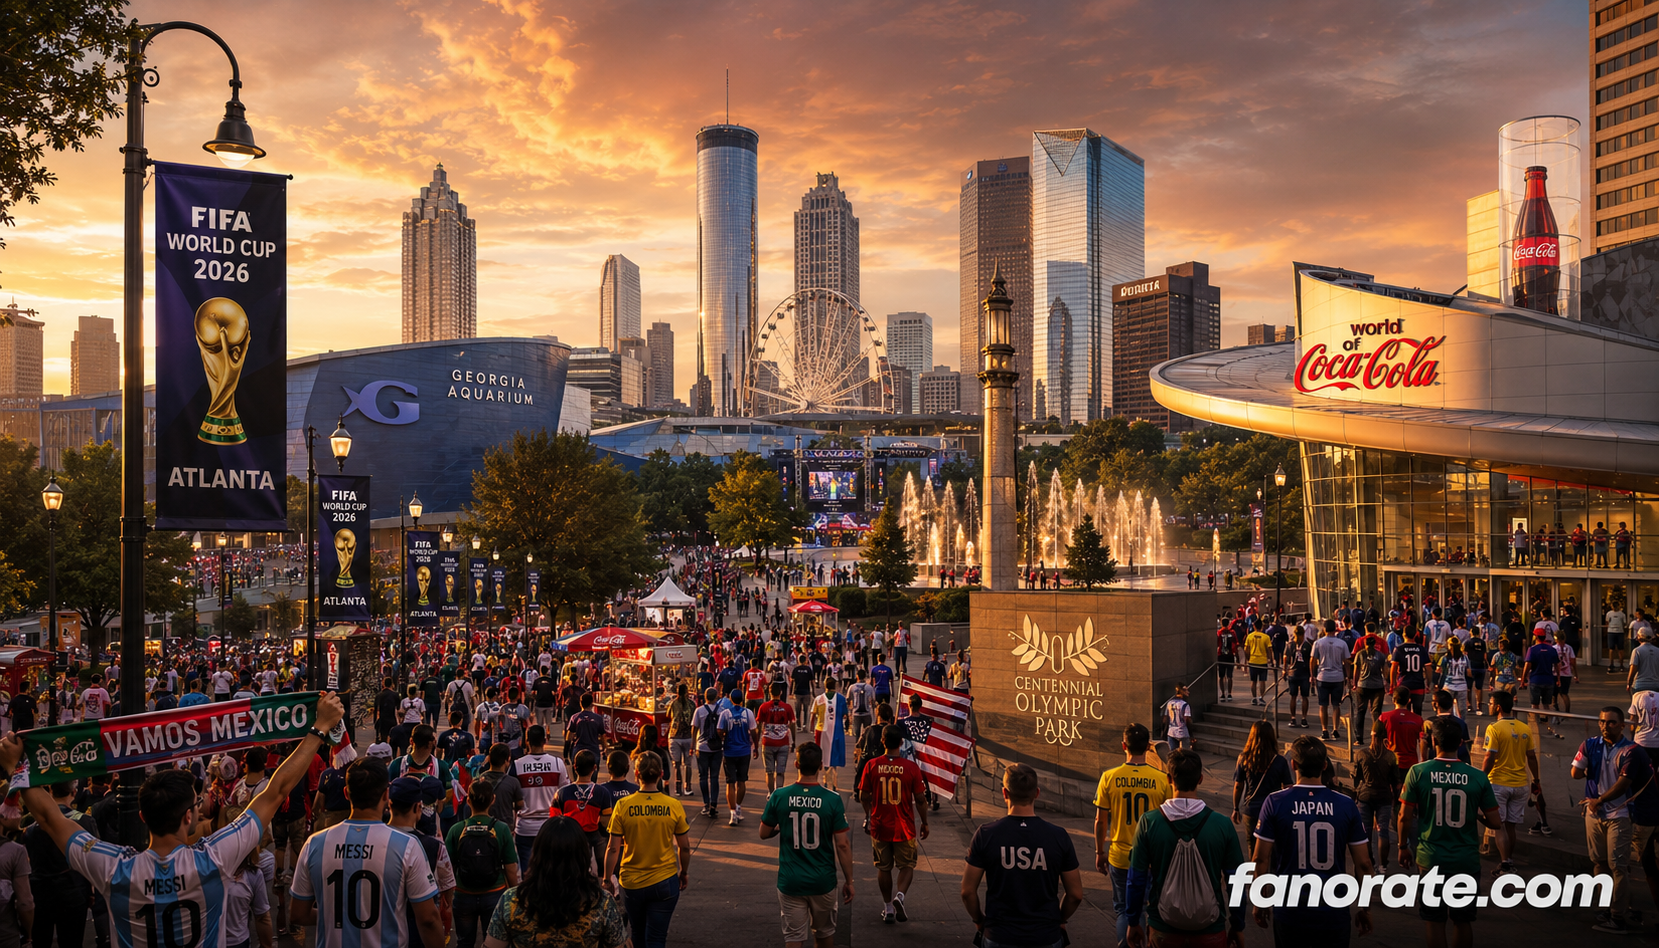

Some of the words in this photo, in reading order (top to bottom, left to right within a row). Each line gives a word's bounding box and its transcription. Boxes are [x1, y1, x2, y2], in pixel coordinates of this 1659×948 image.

[191, 206, 253, 233] FIFA
[166, 232, 235, 256] WORLD
[240, 238, 276, 258] CUP
[194, 258, 250, 283] 2026
[1350, 318, 1404, 337] world
[1342, 337, 1361, 352] of
[1293, 335, 1446, 393] Coca-Cola
[452, 369, 526, 390] GEORGIA
[447, 385, 534, 406] AQUARIUM
[167, 466, 276, 491] ATLANTA
[322, 502, 350, 511] WORLD
[352, 502, 367, 511] CUP
[331, 490, 357, 501] FIFA
[332, 512, 356, 522] 2026
[323, 596, 367, 606] ATLANTA
[1405, 653, 1420, 672] 10
[1014, 675, 1104, 697] CENTENNIAL
[1015, 692, 1104, 720] OLYMPIC
[103, 719, 201, 759] VAMOS
[210, 702, 308, 743] MEXICO
[1035, 716, 1083, 741] PARK
[1430, 771, 1468, 786] MEXICO
[880, 776, 902, 806] 10
[628, 805, 671, 818] COLOMBIA
[788, 796, 822, 810] MEXICO
[1122, 791, 1149, 826] 10
[1291, 800, 1334, 816] JAPAN
[1431, 787, 1467, 829] 10
[788, 811, 821, 850] 10
[334, 844, 373, 860] MESSI
[1292, 820, 1335, 870] 10
[1000, 846, 1048, 871] USA
[144, 874, 186, 896] MESSI
[326, 869, 381, 930] 10
[135, 899, 202, 948] 10
